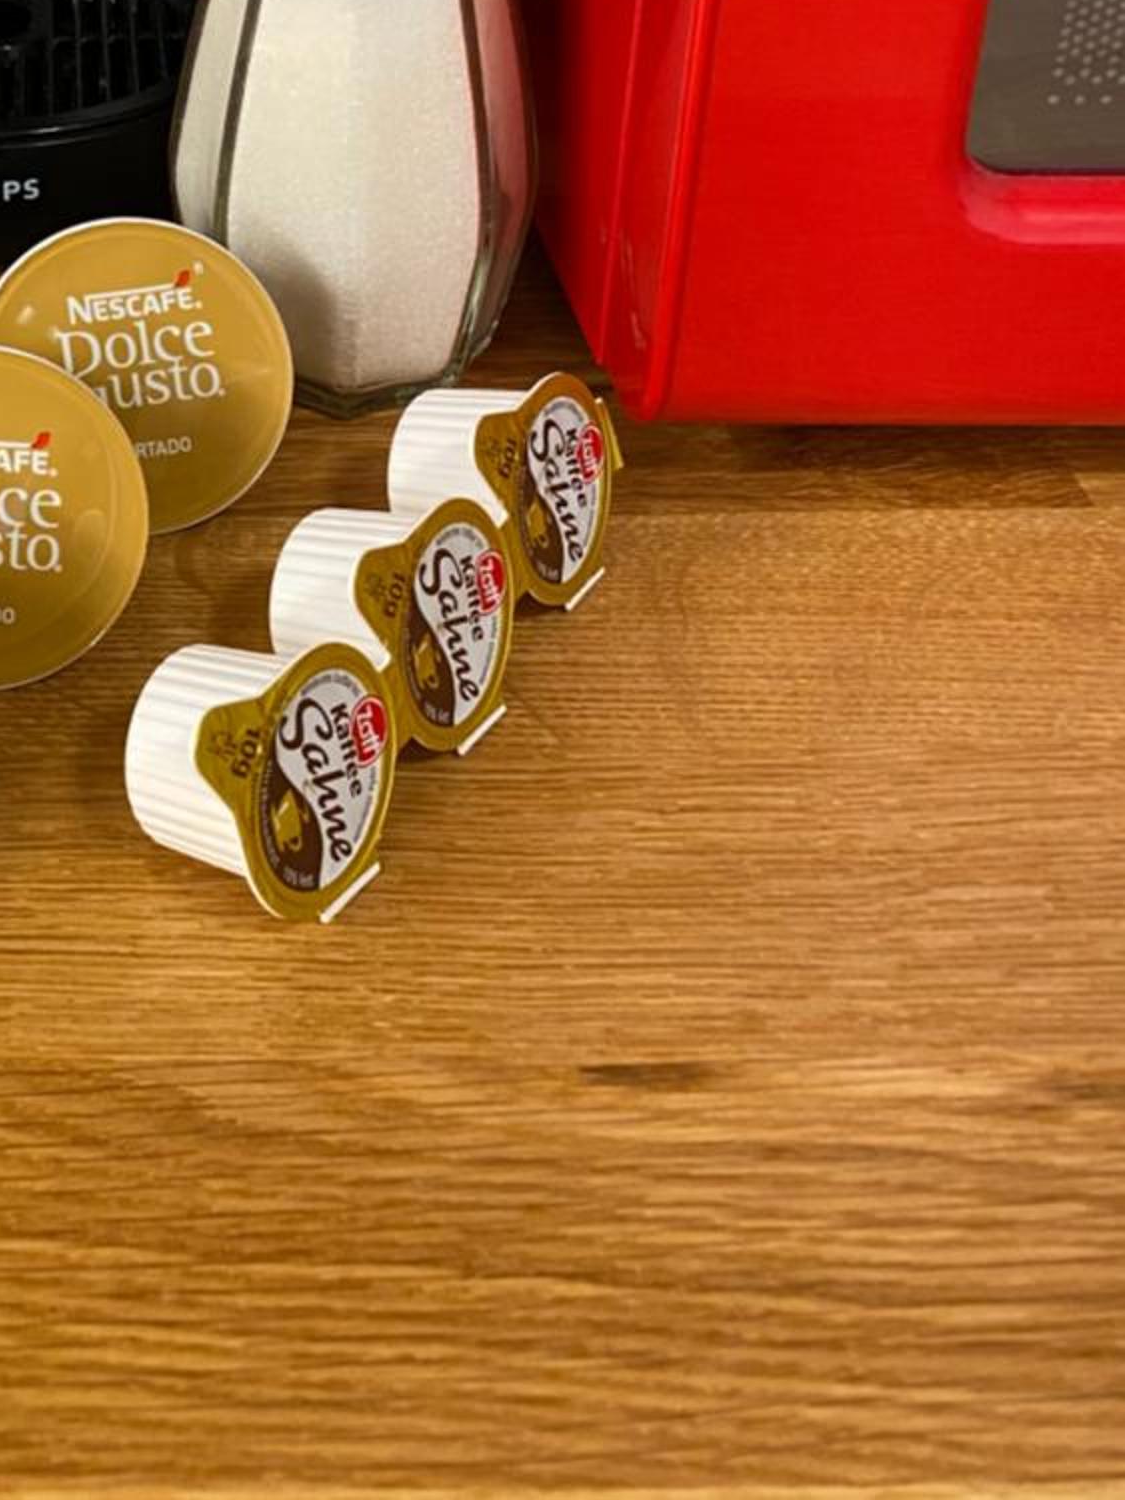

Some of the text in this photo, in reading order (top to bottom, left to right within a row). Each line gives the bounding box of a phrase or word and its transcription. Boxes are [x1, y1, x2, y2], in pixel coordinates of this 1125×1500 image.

[53, 319, 216, 378] Dolce
[530, 419, 583, 562] Sahne
[419, 548, 479, 702] Sahne
[279, 698, 352, 862] Sahne
